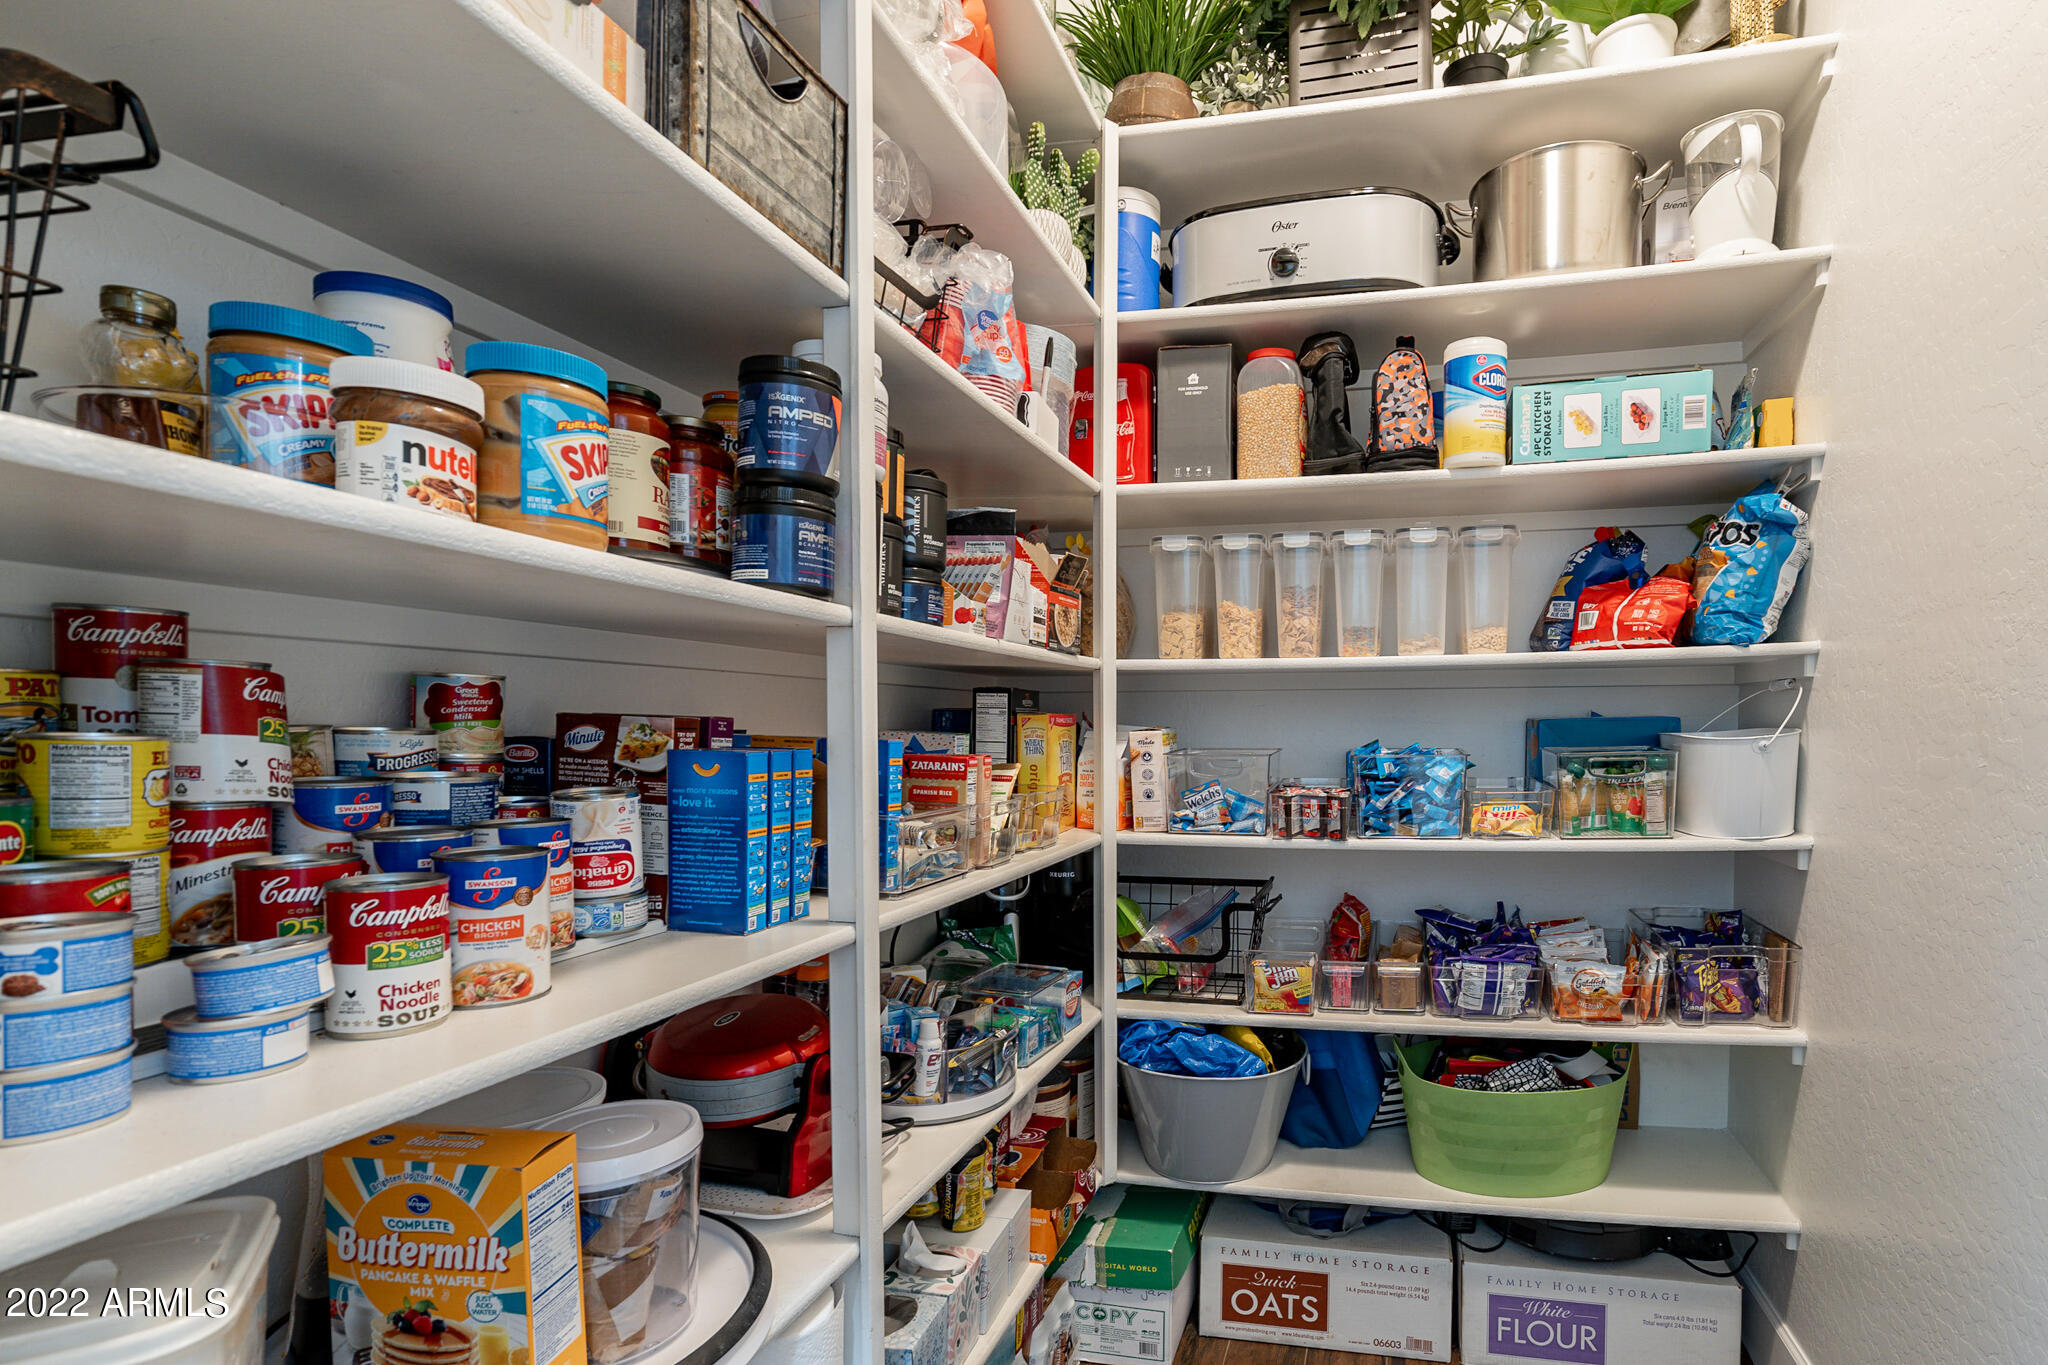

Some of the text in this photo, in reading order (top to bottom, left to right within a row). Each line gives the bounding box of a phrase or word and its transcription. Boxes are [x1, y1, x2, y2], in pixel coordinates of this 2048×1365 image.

[1271, 220, 1299, 233] Oster
[235, 370, 330, 386] FUEL the FU
[767, 405, 834, 429] AMPED
[767, 419, 797, 427] NITRO
[1533, 391, 1542, 457] 4PC KITCHEN
[1543, 390, 1552, 456] STORAGE SET
[556, 420, 588, 431] FUEL
[1519, 394, 1532, 456] Cuisinart
[278, 438, 327, 456] CREAMY
[454, 686, 479, 694] Great
[440, 705, 489, 713] Condensed
[452, 698, 494, 706] Sweetened
[453, 712, 473, 720] Milk
[564, 728, 606, 748] Minute
[1023, 739, 1045, 750] WHEAT
[508, 747, 536, 758] Barilla
[1023, 745, 1045, 756] THINS
[911, 760, 966, 772] ZATARAIN'S
[615, 777, 638, 787] Fast
[912, 788, 953, 797] SPANISH RICE
[1187, 787, 1222, 810] Welch's
[337, 804, 381, 813] SWANSON
[678, 796, 716, 808] love it.
[1491, 804, 1520, 812] mini
[467, 879, 515, 890] SWANSON
[460, 918, 521, 934] CHICKEN
[473, 930, 509, 940] BROTH
[371, 940, 419, 964] 25%
[419, 937, 442, 950] LESS
[408, 945, 443, 959] SODIUM
[377, 978, 441, 999] Chicken
[1574, 976, 1607, 990] Goldfish
[379, 991, 440, 1012] Noodle
[377, 1005, 441, 1028] SOUP
[370, 1171, 469, 1196] Brighten Up Your Morning!
[387, 1217, 451, 1232] COMPLETE
[336, 1225, 511, 1274] Buttermilk
[1096, 1262, 1158, 1273] DIGITAL WORLD
[1219, 1246, 1432, 1276] FAMILY HOME STORAGE
[360, 1269, 486, 1289] PANCAKE & WAFFLE
[1247, 1270, 1298, 1291] Quick
[410, 1286, 435, 1299] MIX
[1486, 1275, 1682, 1303] FAMILY HOME STORAGE
[474, 1295, 493, 1303] JUST
[1230, 1287, 1320, 1324] OATS
[471, 1308, 498, 1316] WATER
[1075, 1304, 1139, 1326] COPY
[1521, 1299, 1574, 1320] White
[1496, 1316, 1599, 1352] FLOUR
[1372, 1338, 1402, 1349] 06603
